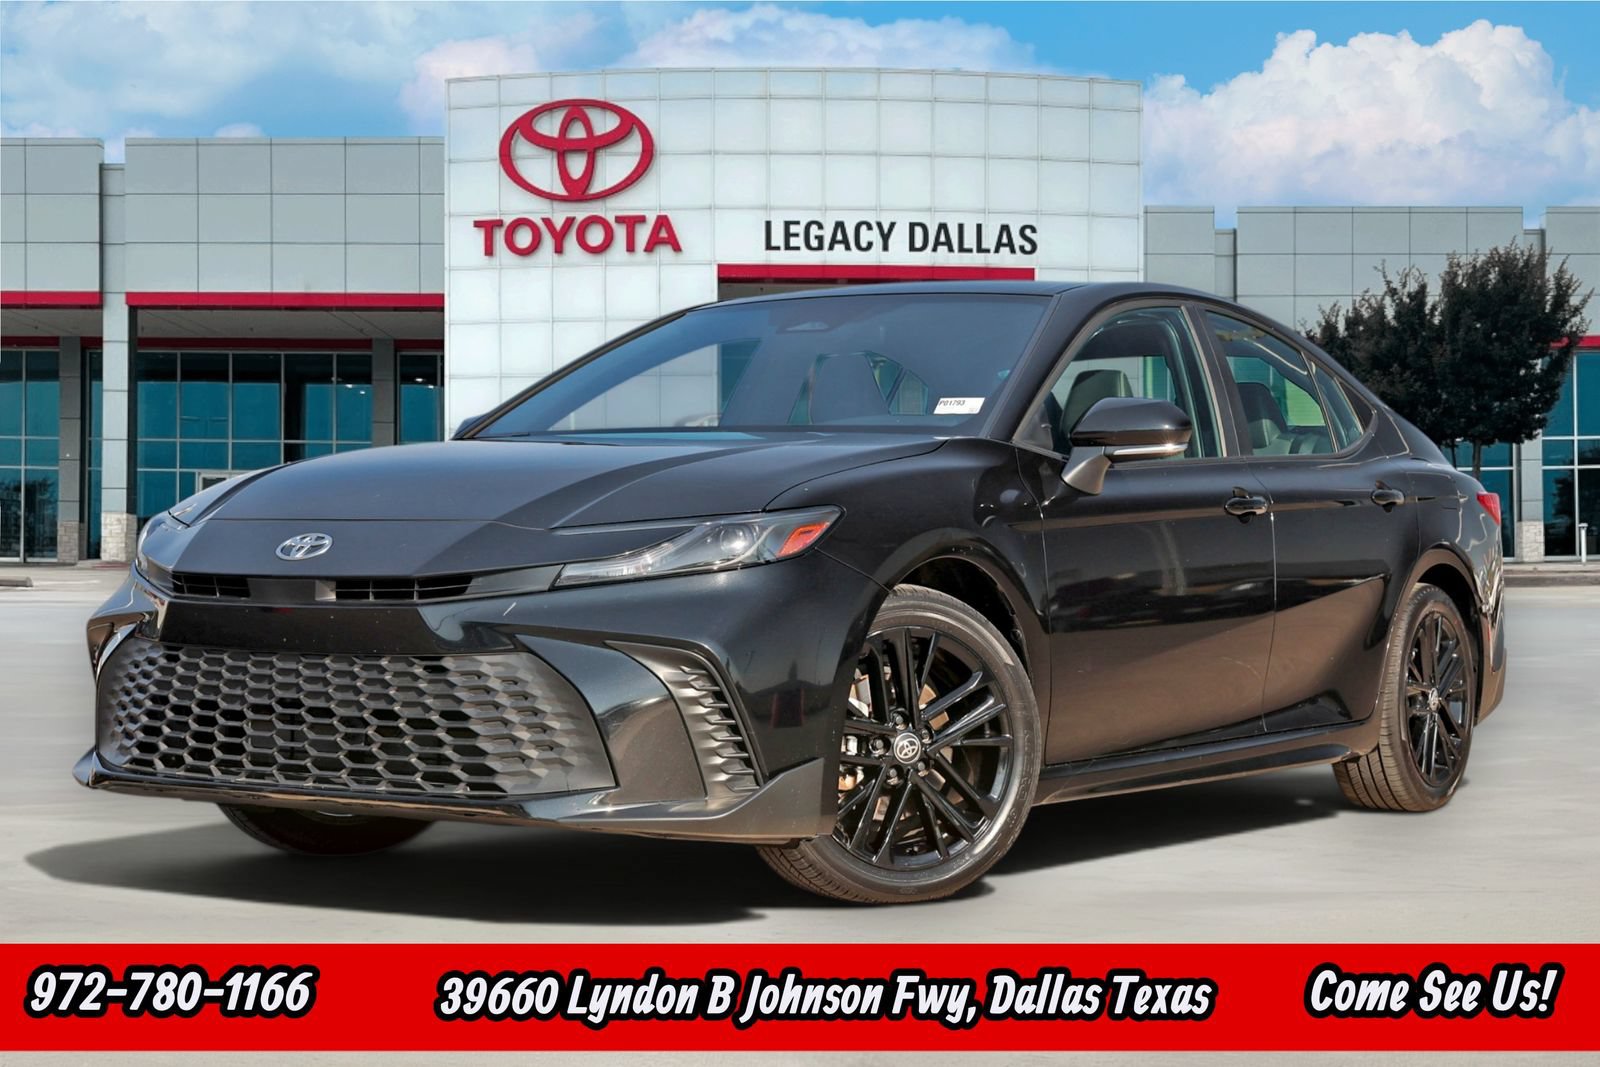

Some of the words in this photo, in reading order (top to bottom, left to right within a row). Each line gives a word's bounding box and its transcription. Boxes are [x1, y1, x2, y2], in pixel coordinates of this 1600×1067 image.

[474, 214, 682, 256] TOYOTA
[765, 220, 897, 252] LEGACY
[908, 221, 1038, 255] DALLAS
